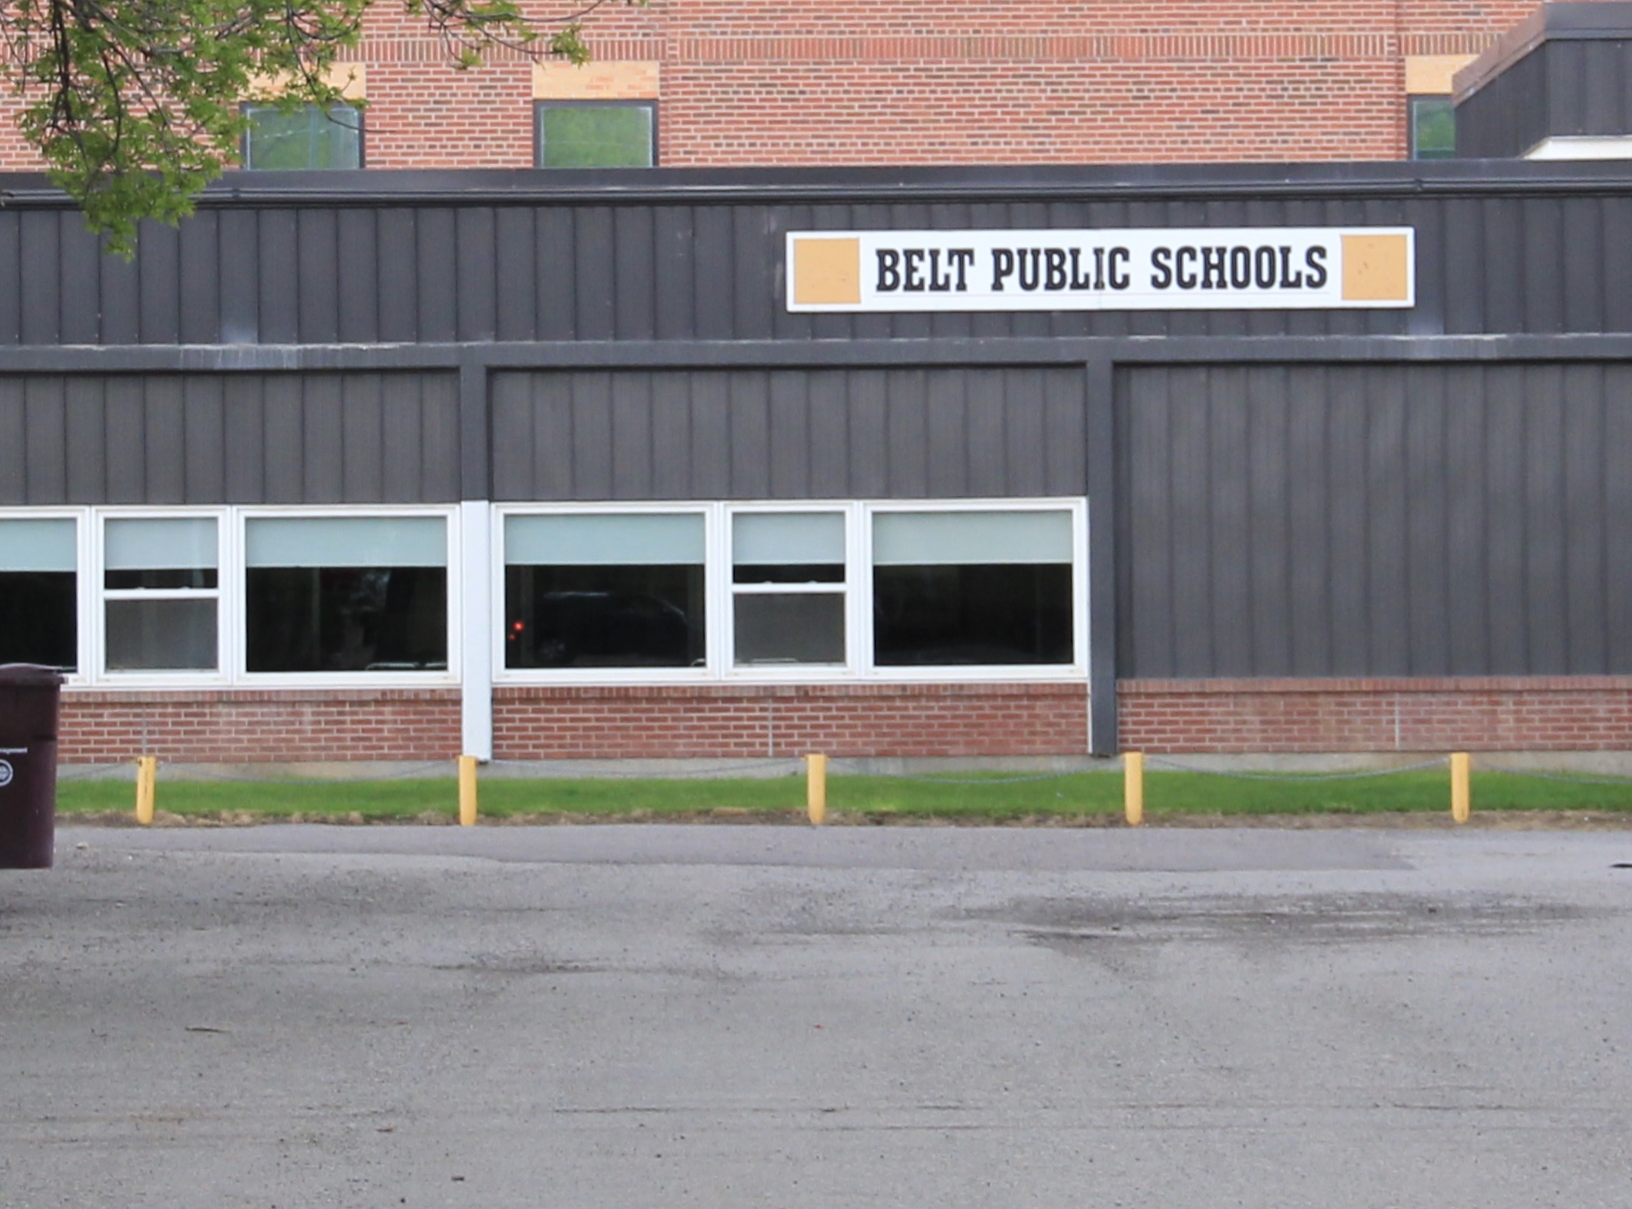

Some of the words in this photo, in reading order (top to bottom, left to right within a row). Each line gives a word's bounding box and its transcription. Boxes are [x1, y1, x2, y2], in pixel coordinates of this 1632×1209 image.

[875, 247, 975, 292] BELT
[991, 246, 1131, 292] PUBLIC
[1149, 244, 1329, 291] SCHOOLS
